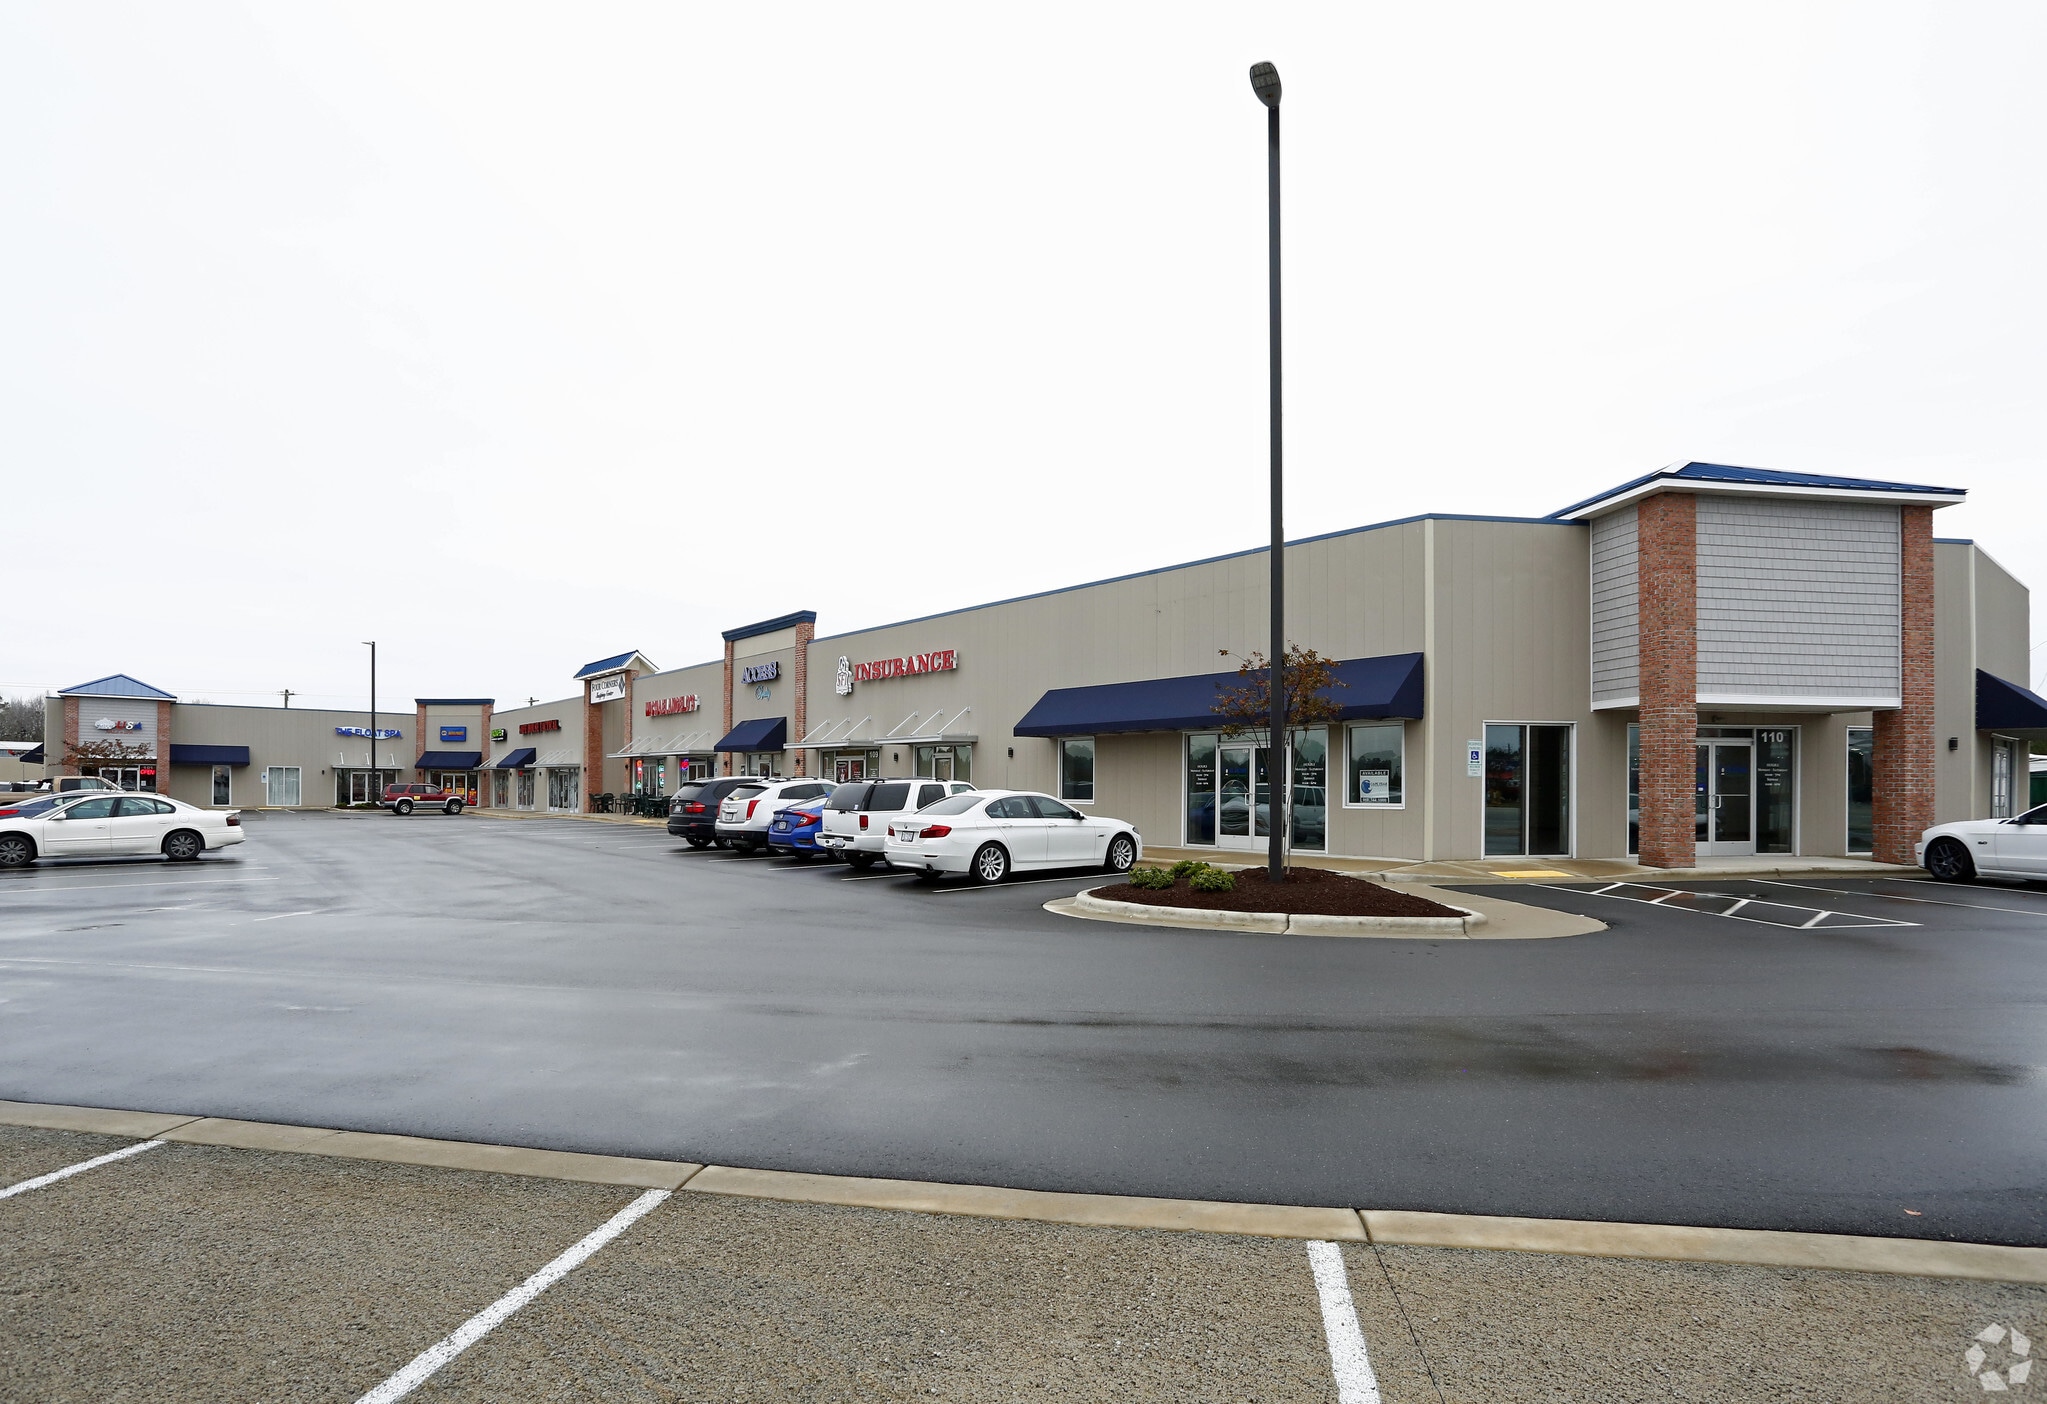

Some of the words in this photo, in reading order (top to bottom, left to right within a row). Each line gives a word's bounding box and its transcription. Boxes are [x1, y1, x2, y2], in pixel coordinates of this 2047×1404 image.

[854, 650, 956, 682] INSURANCE
[741, 661, 777, 684] ACCESS
[602, 679, 618, 689] CORNERS
[384, 729, 401, 738] SPA
[1761, 731, 1784, 743] 110
